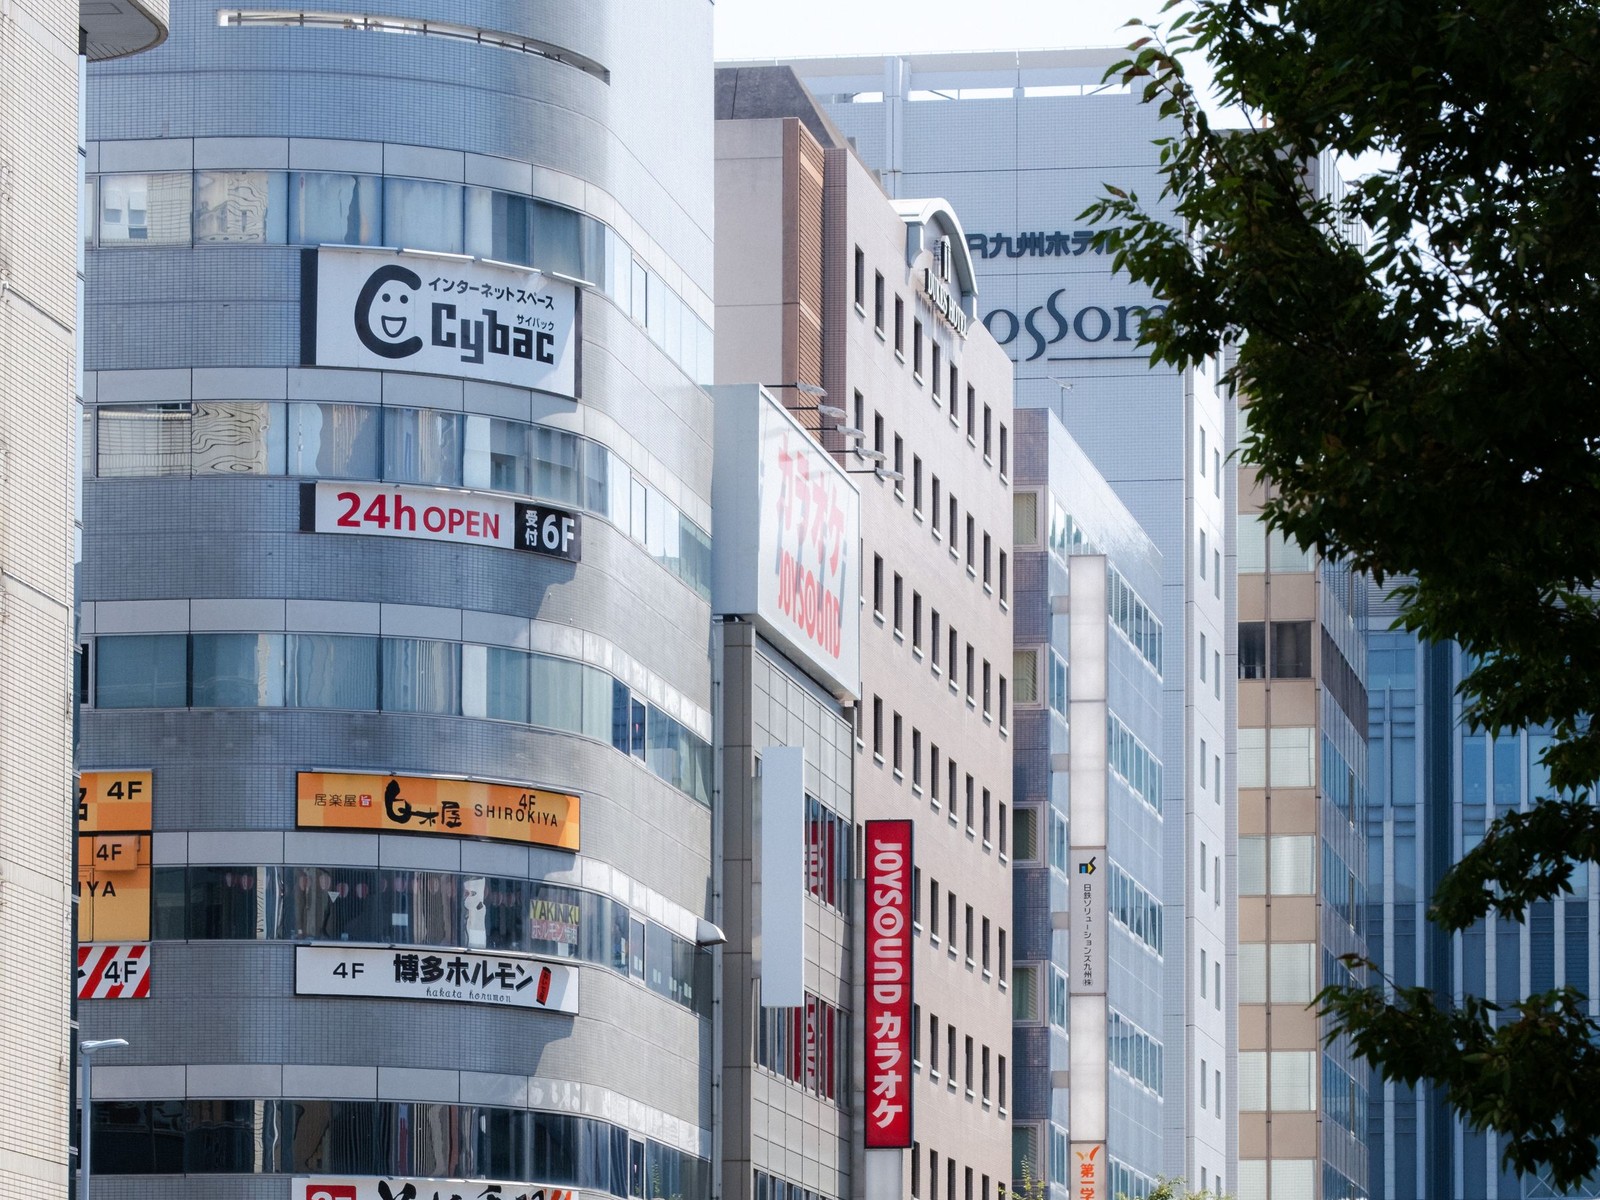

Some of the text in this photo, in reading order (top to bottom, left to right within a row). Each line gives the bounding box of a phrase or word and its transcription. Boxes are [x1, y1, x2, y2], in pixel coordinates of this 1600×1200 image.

[428, 277, 555, 310] インターネットスペース
[431, 302, 554, 365] Cybac
[516, 314, 555, 331] サイバック
[336, 491, 499, 539] 24h OPEN
[776, 431, 845, 577] カラオケ
[525, 509, 538, 547] 受付
[541, 513, 575, 552] 6F
[778, 548, 841, 660] JOYSOUND
[106, 780, 143, 800] 4F
[314, 793, 357, 807] 居楽屋
[384, 779, 462, 828] 白木屋
[518, 793, 537, 812] 4F
[474, 804, 558, 827] SHIROKIYA
[96, 843, 123, 861] 4F
[873, 839, 904, 1004] JOYSOUND
[104, 961, 138, 983] 4F
[332, 962, 365, 979] 4F
[393, 954, 534, 991] 博多ホルモン
[426, 986, 512, 1003] hakata horumon
[872, 1011, 903, 1129] カラオケ
